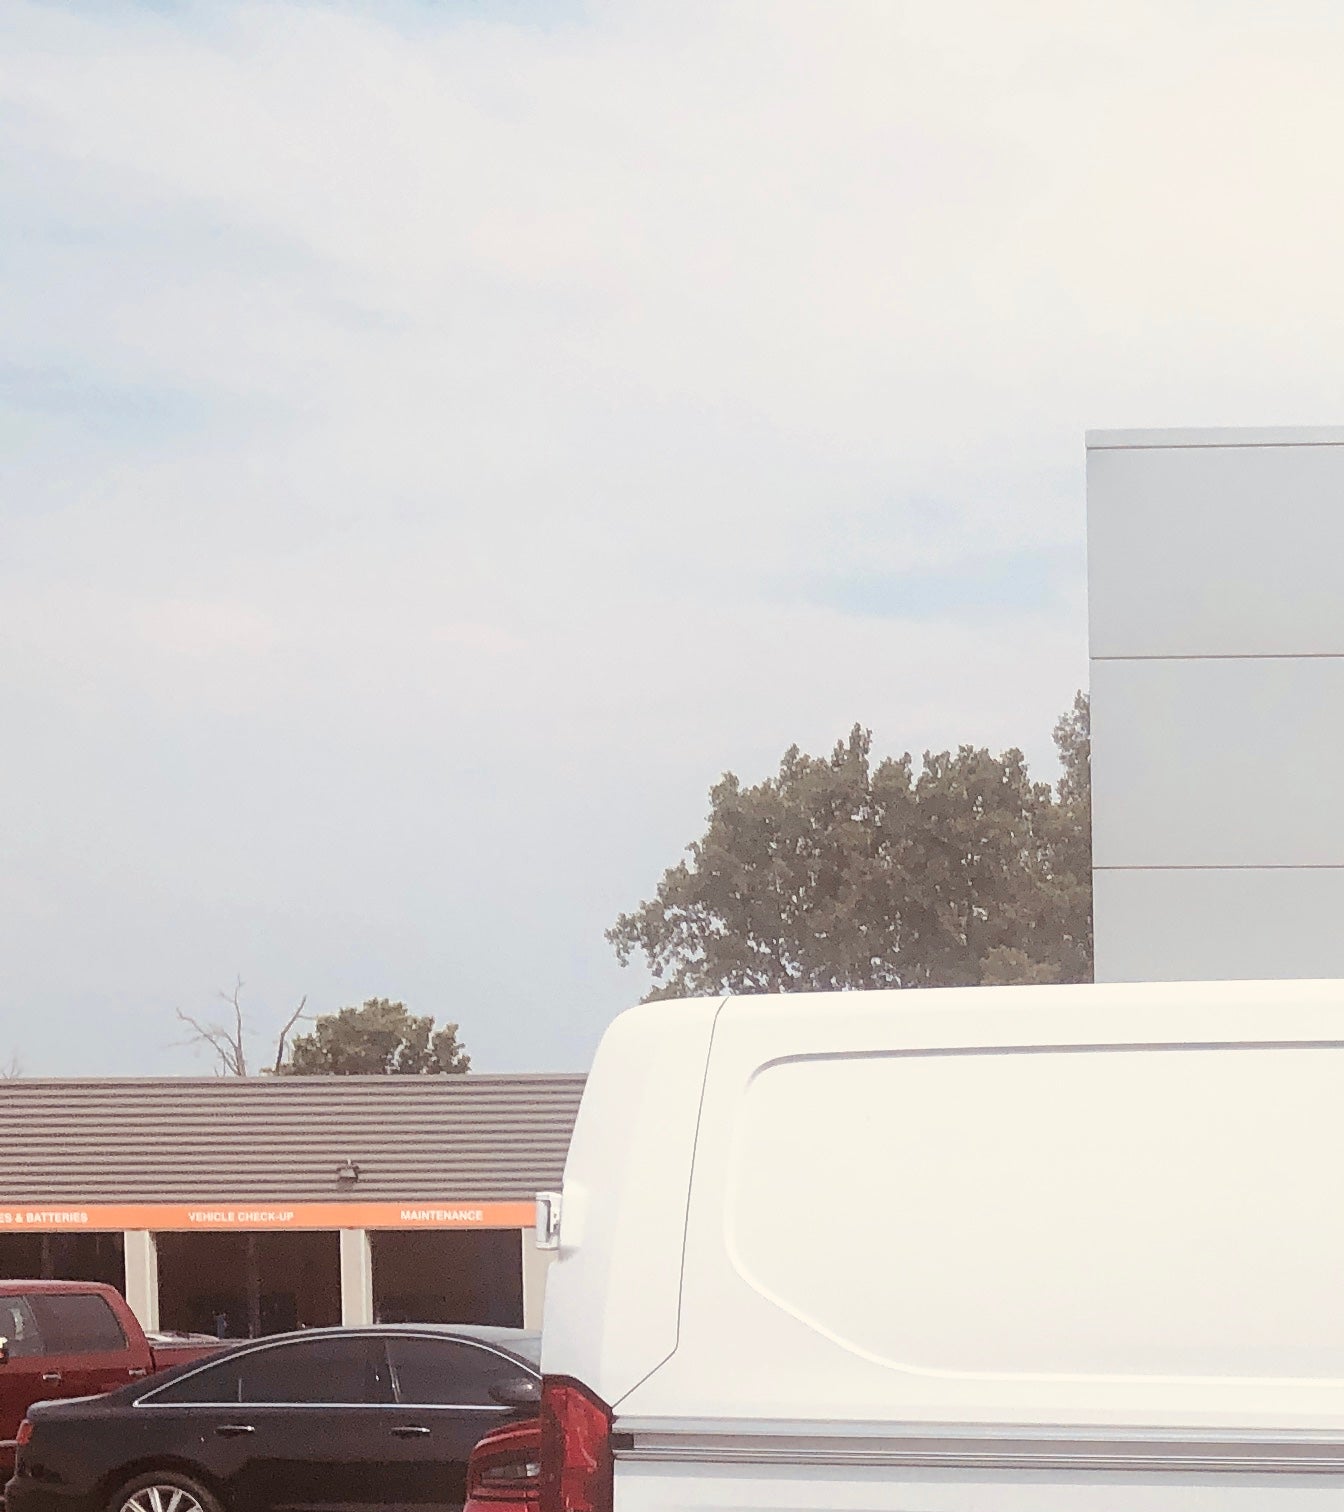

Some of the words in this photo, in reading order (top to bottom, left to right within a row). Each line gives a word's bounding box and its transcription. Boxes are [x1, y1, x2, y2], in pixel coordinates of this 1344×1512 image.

[15, 1211, 24, 1223] &
[26, 1211, 89, 1223] BATTERIES
[188, 1211, 234, 1221] VEHICLE
[237, 1211, 294, 1222] CHECK-UP
[400, 1210, 483, 1220] MAINTENANCE
